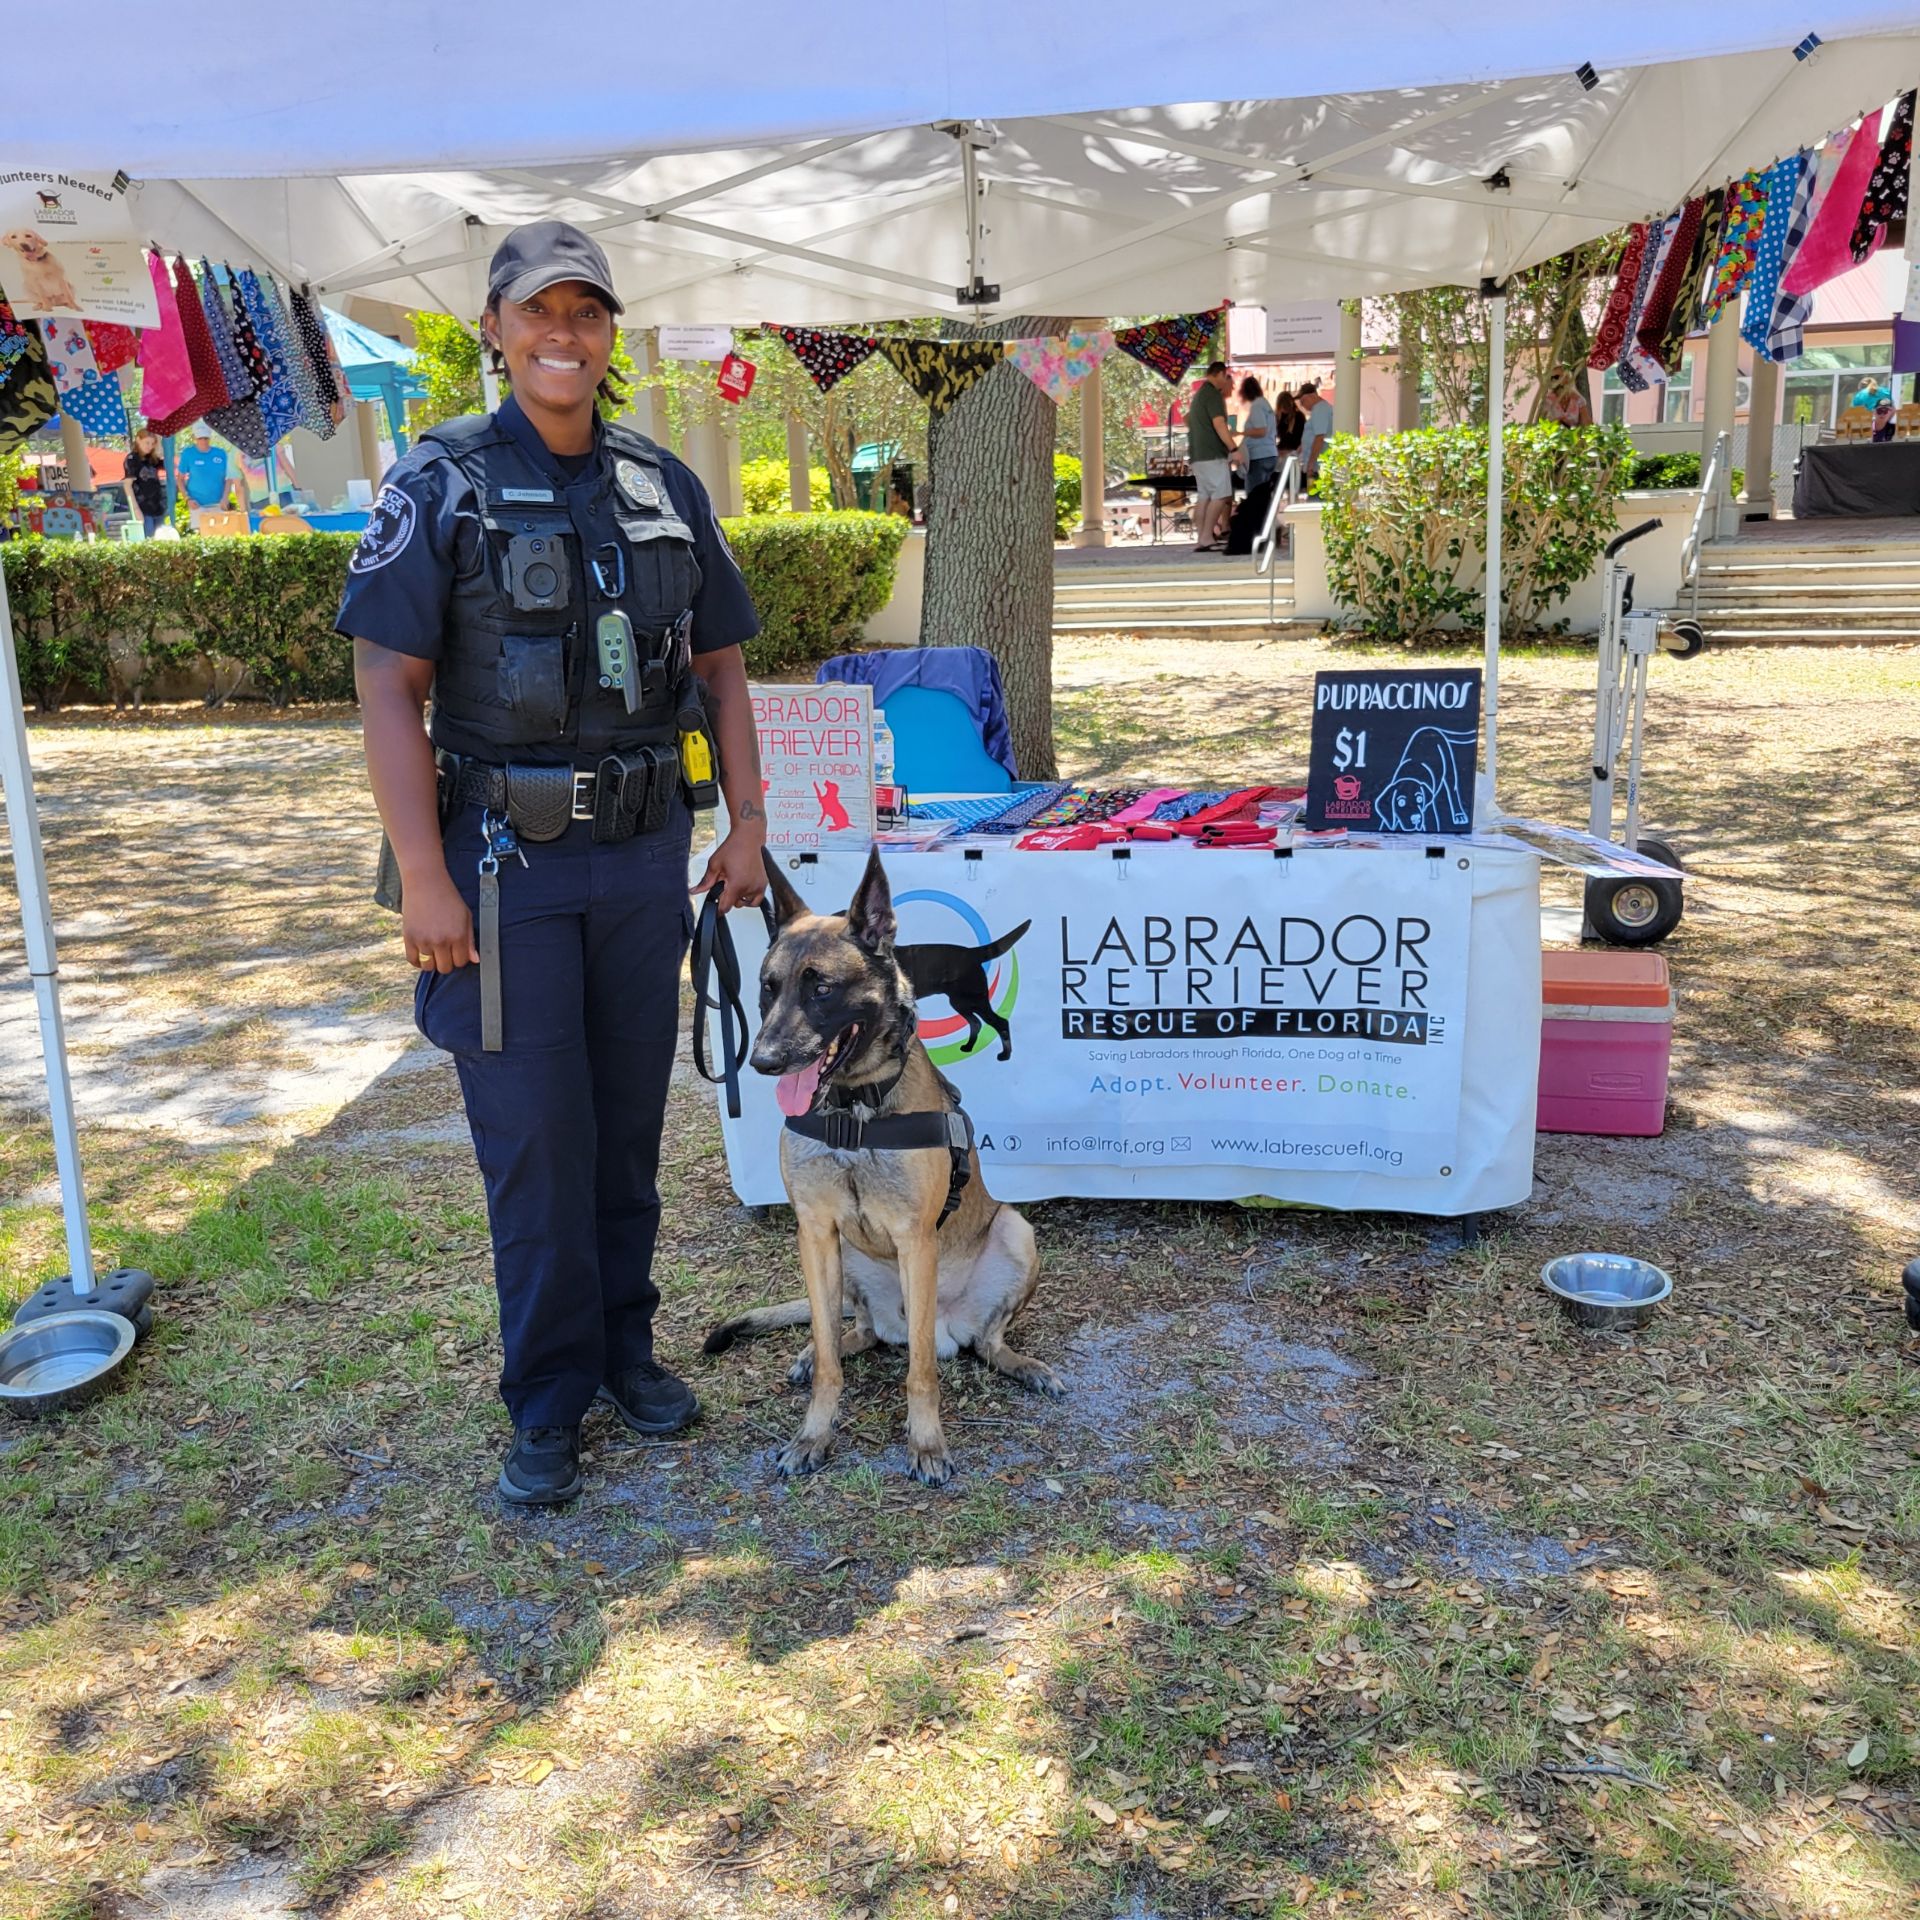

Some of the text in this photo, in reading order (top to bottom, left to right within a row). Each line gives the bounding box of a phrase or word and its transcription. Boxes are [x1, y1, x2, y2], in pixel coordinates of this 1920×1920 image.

[0, 171, 114, 202] lunteers Needed
[380, 500, 402, 519] COA
[381, 489, 407, 508] LICE
[361, 554, 380, 567] UNIT
[751, 697, 861, 723] BRADOR
[1316, 682, 1473, 711] PUPPACCINOS
[757, 729, 862, 756] TRIEVER
[1332, 727, 1366, 772] $1
[809, 763, 862, 776] FLORIDA
[1061, 914, 1432, 968] LABRADOR
[1061, 967, 1430, 1008] RETRIEVER
[1068, 1011, 1421, 1039] RESCUE OF FLORIDA
[1428, 1016, 1445, 1044] INC
[1088, 1047, 1402, 1065] Saving Labradors through Florida, One Dog at a Time
[1090, 1072, 1416, 1100] Adopt. Volunteer. Donate.
[1211, 1138, 1403, 1166] www.labrescuefl.org
